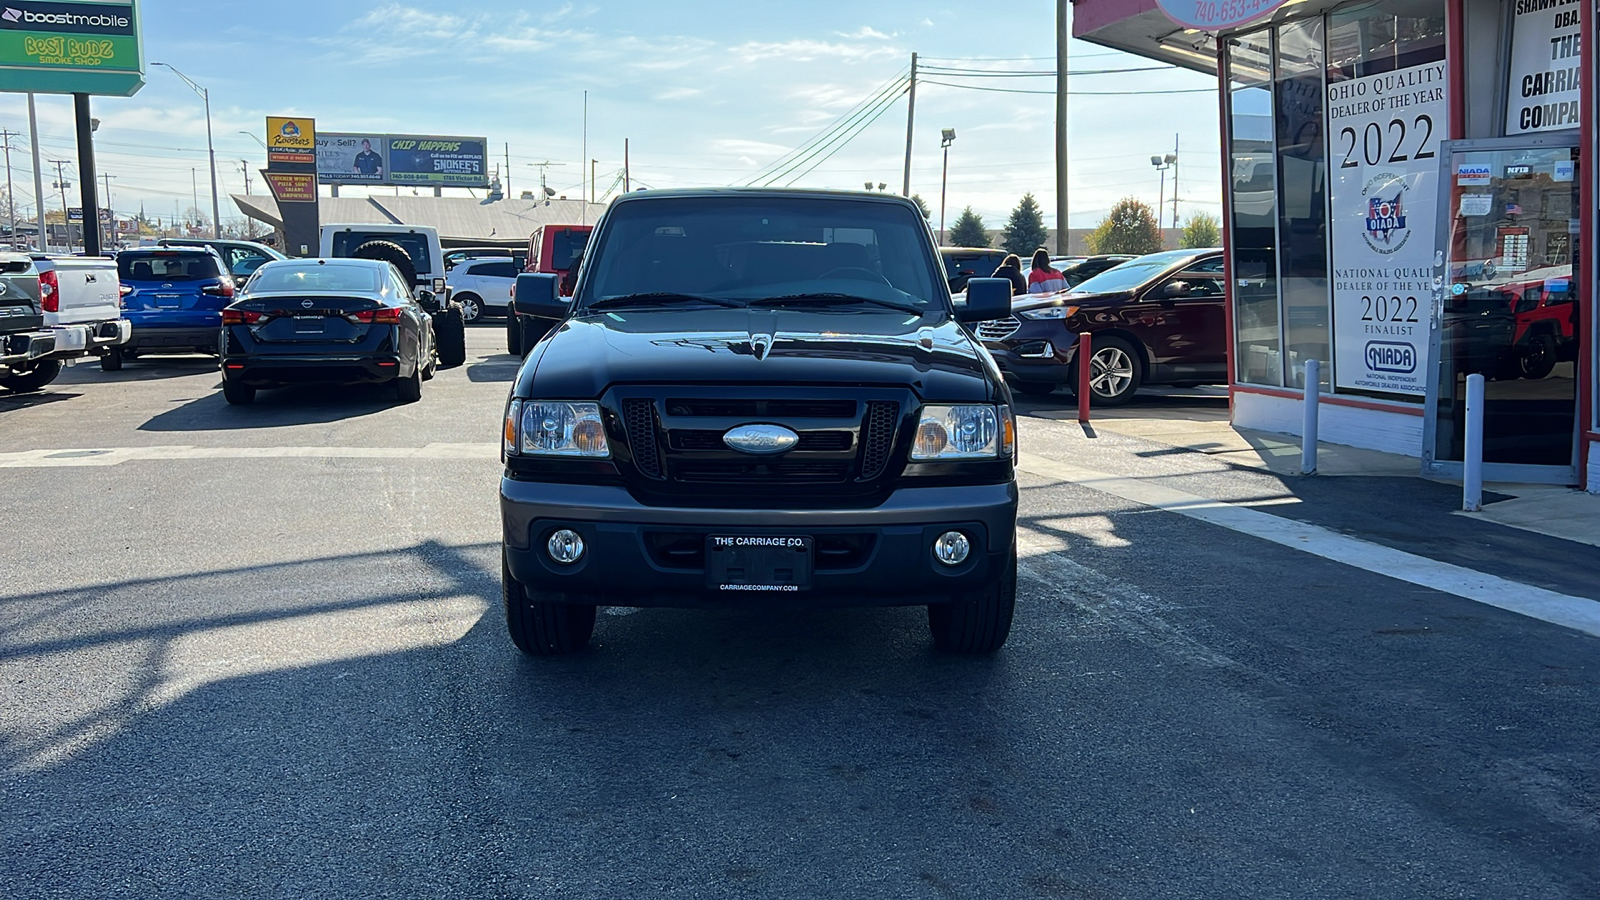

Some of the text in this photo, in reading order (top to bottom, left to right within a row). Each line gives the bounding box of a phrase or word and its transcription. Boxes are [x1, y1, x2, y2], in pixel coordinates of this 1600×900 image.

[1194, 0, 1269, 23] 740-653-4
[23, 10, 129, 27] boostmobile
[1554, 9, 1580, 29] DBA.
[67, 38, 114, 59] BUDZ
[39, 56, 101, 66] SMOKE SHOP
[1329, 65, 1445, 101] OHIO QUALITY
[1331, 87, 1443, 119] DEALER OF THE YEAR
[1520, 101, 1580, 130] COMPA
[272, 134, 310, 146] Roosters
[337, 139, 357, 147] Sell?
[391, 140, 461, 151] CHIP HAPPENS
[1340, 114, 1435, 169] 2022
[1370, 218, 1399, 230] OIADA
[1335, 267, 1433, 280] NATIONAL QUALI
[1336, 281, 1432, 291] DEALER OF THE YE
[1360, 295, 1419, 323] 2022
[1365, 324, 1413, 336] FINALIST
[1369, 347, 1411, 367] NIADA
[1354, 380, 1380, 388] AUTOMOBILE
[1387, 375, 1417, 383] INDEPENDENT
[742, 430, 780, 446] Ford
[714, 537, 804, 547] THE CARRIAGE CO.
[719, 584, 798, 592] CARRIAGECOMPANY.COM
